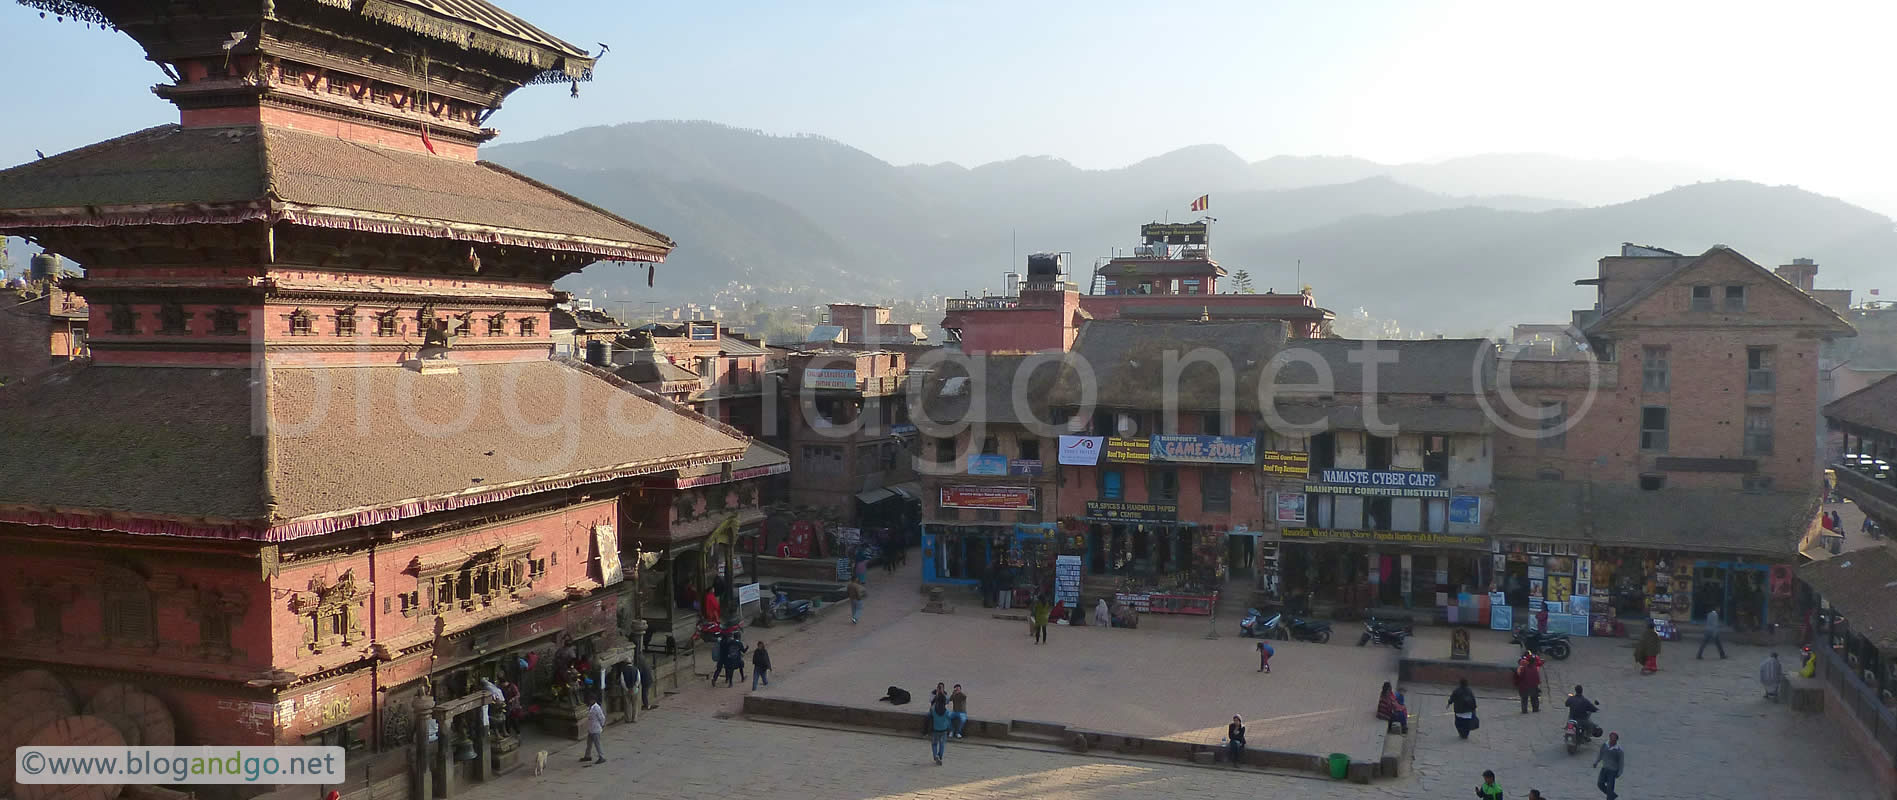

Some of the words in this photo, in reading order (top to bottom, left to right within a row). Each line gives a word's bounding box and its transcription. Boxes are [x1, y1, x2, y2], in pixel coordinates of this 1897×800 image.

[1107, 450, 1118, 458] Roof
[1118, 451, 1126, 460] Top
[1126, 451, 1150, 459] Restaurant
[1166, 442, 1241, 457] GAME-ZONE
[1264, 464, 1274, 472] Roof
[1274, 465, 1283, 474] Top
[1323, 470, 1369, 484] NAMASTE
[1372, 472, 1405, 486] CYBER
[1408, 473, 1436, 487] CAFE
[1305, 485, 1353, 494] MAINPOINT
[1354, 487, 1402, 496] COMPUTER
[1403, 489, 1449, 498] INSTITUTE
[1126, 503, 1156, 512] HANDMADE
